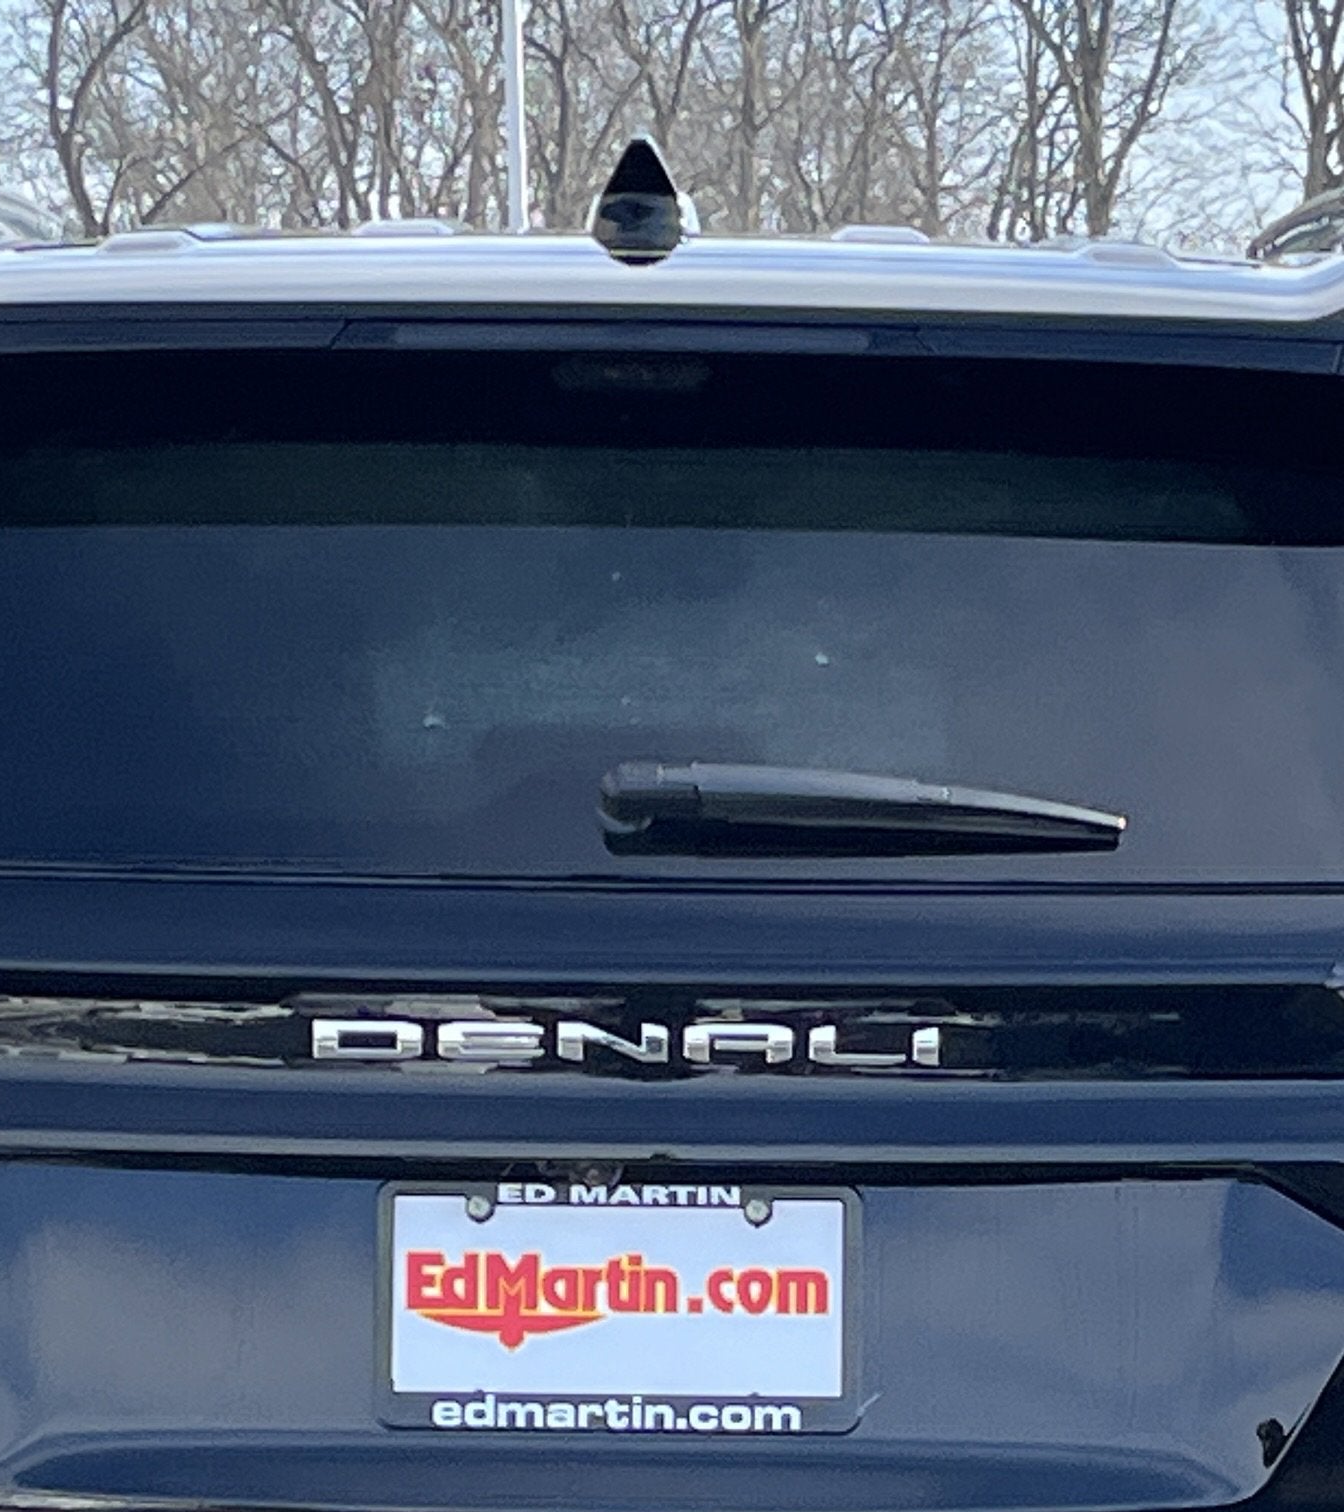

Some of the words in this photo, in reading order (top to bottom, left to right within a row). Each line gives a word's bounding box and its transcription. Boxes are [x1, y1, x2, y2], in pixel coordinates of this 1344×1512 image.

[311, 1018, 942, 1067] DENALI
[497, 1184, 556, 1205] ED
[569, 1185, 741, 1206] MARTIN
[406, 1251, 830, 1316] EdMartin.com
[431, 1394, 803, 1432] edmartin.com
